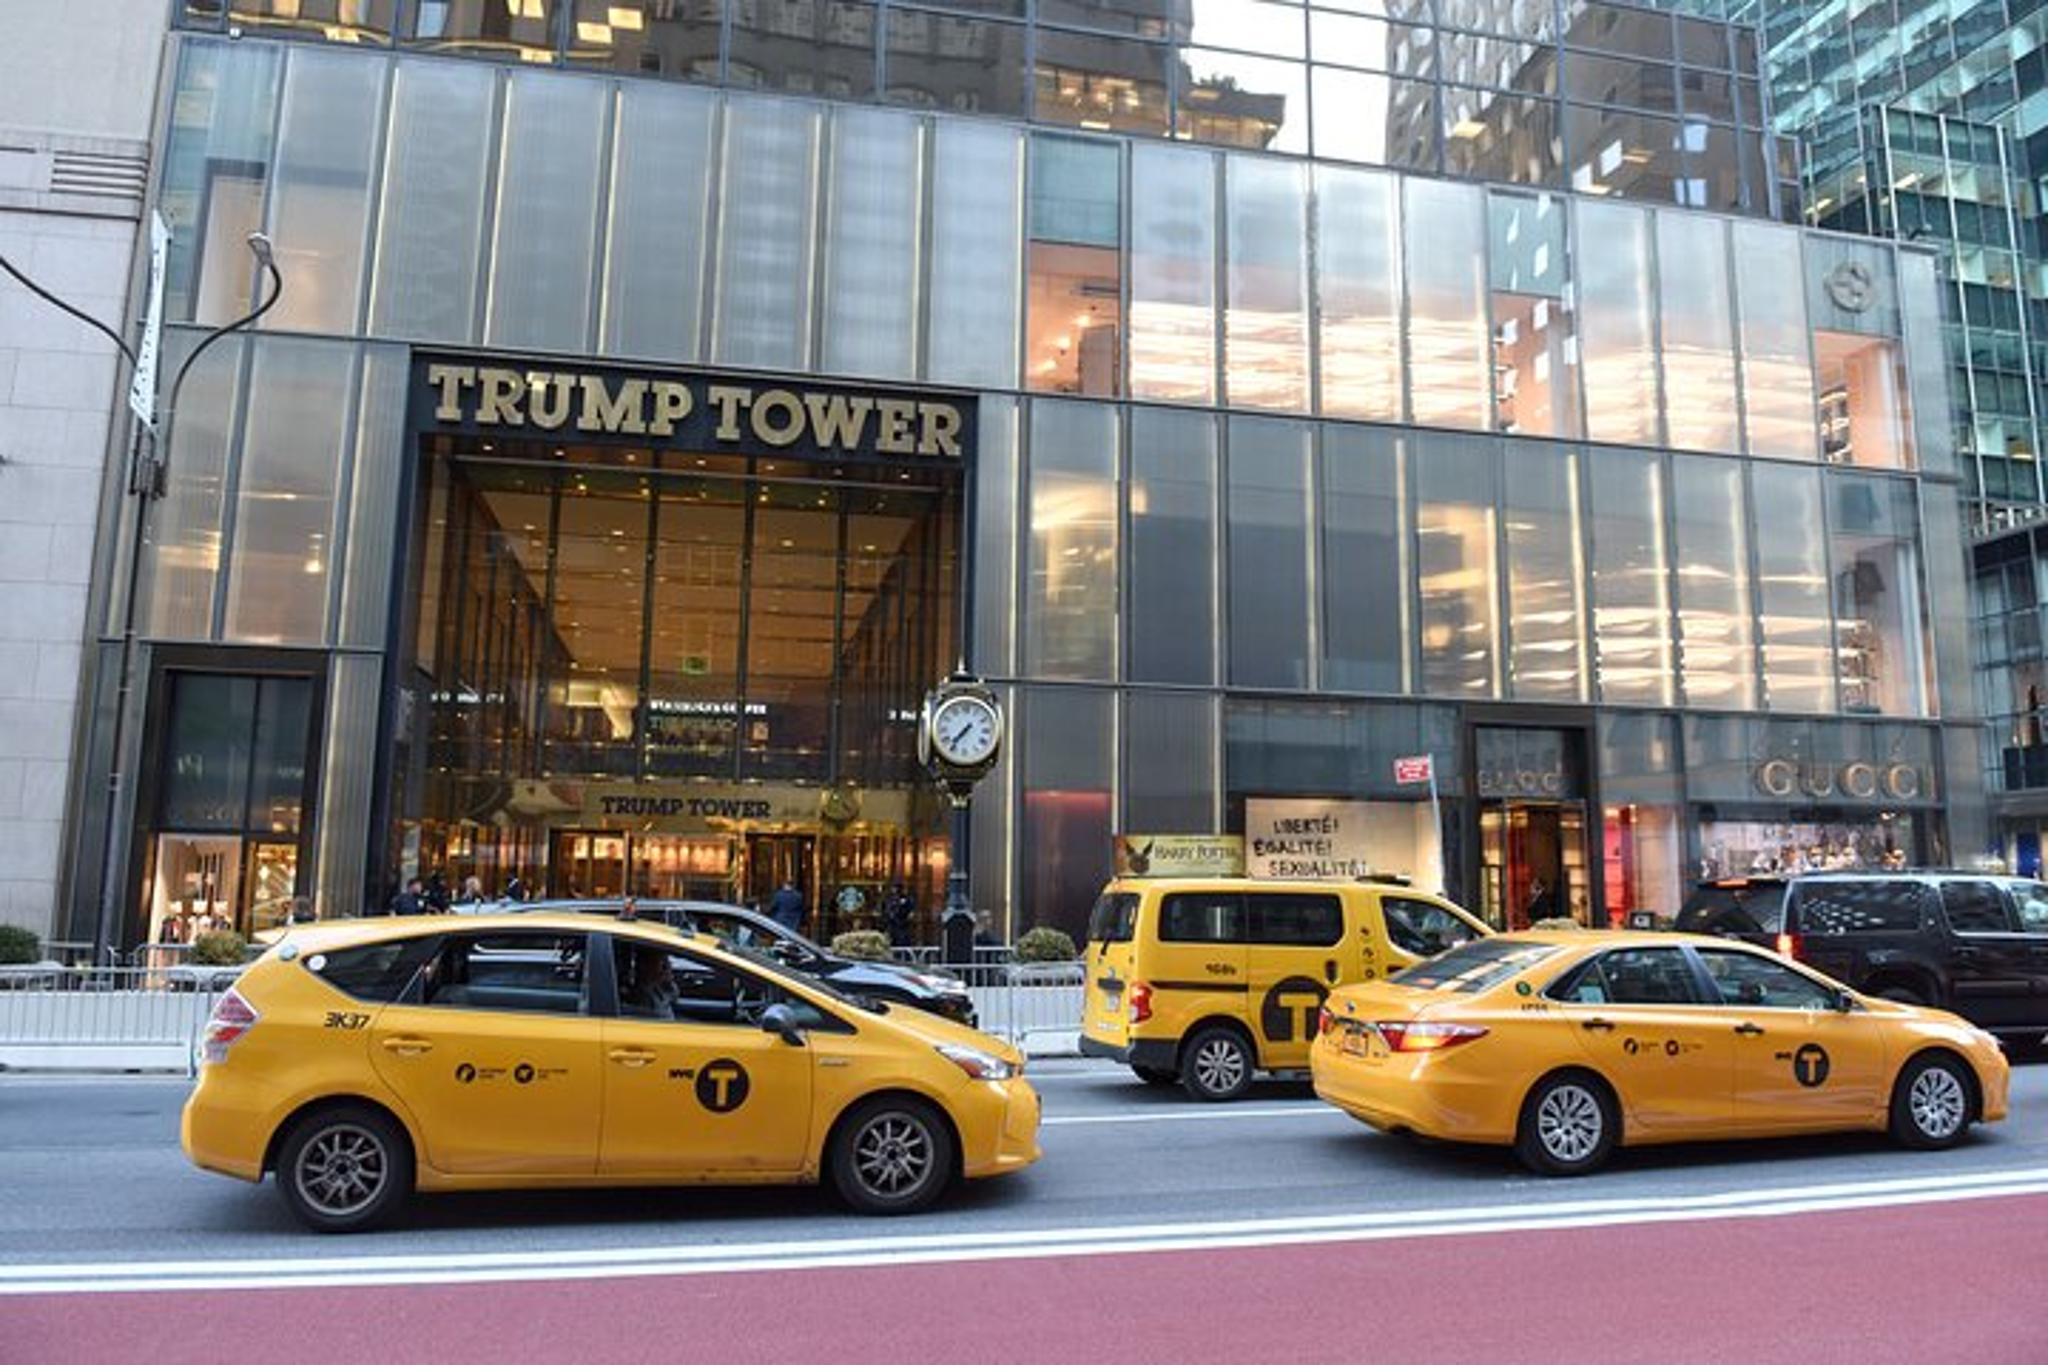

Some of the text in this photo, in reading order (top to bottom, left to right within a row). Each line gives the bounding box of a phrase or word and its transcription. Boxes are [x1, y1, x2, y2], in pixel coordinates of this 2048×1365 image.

[428, 363, 963, 457] TRUMP TOWER
[600, 797, 771, 817] TRUMP TOWER
[324, 1011, 371, 1030] 3K37
